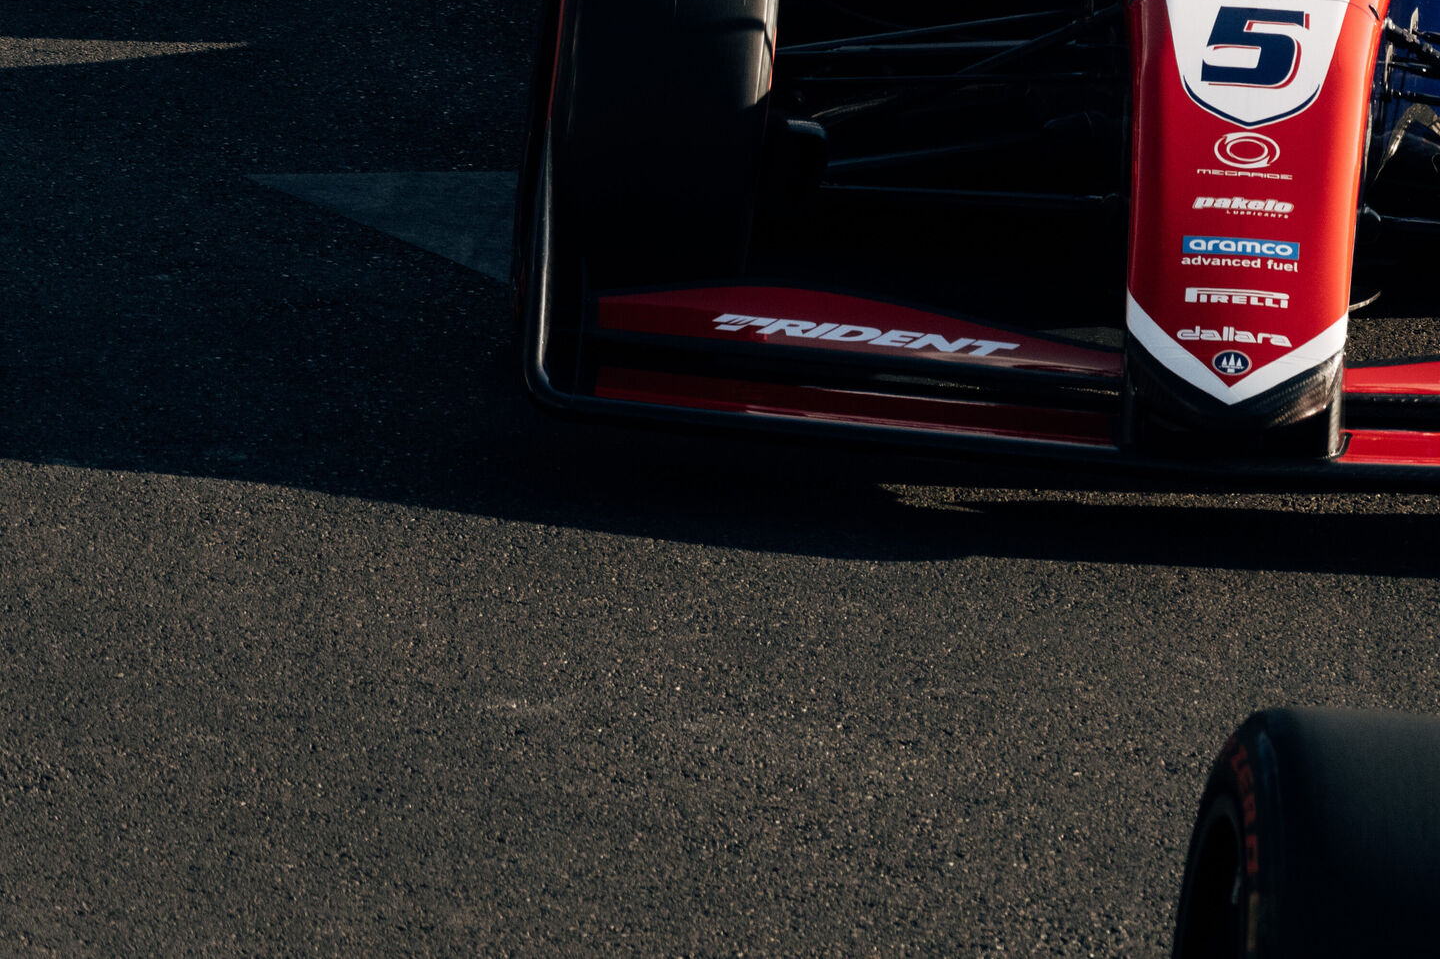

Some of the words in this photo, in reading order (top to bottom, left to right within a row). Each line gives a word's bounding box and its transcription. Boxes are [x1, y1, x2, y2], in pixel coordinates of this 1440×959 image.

[1200, 6, 1310, 90] 5
[1197, 168, 1293, 180] MEGARIDE
[1192, 196, 1295, 214] pakelo
[1226, 209, 1289, 219] LUBRICANTS
[1189, 238, 1293, 256] aramco
[1181, 255, 1261, 269] advanced
[1266, 259, 1298, 272] fuel
[1185, 287, 1290, 309] PIRELLI
[712, 313, 1020, 356] TRIDENT
[1176, 325, 1292, 348] dallara
